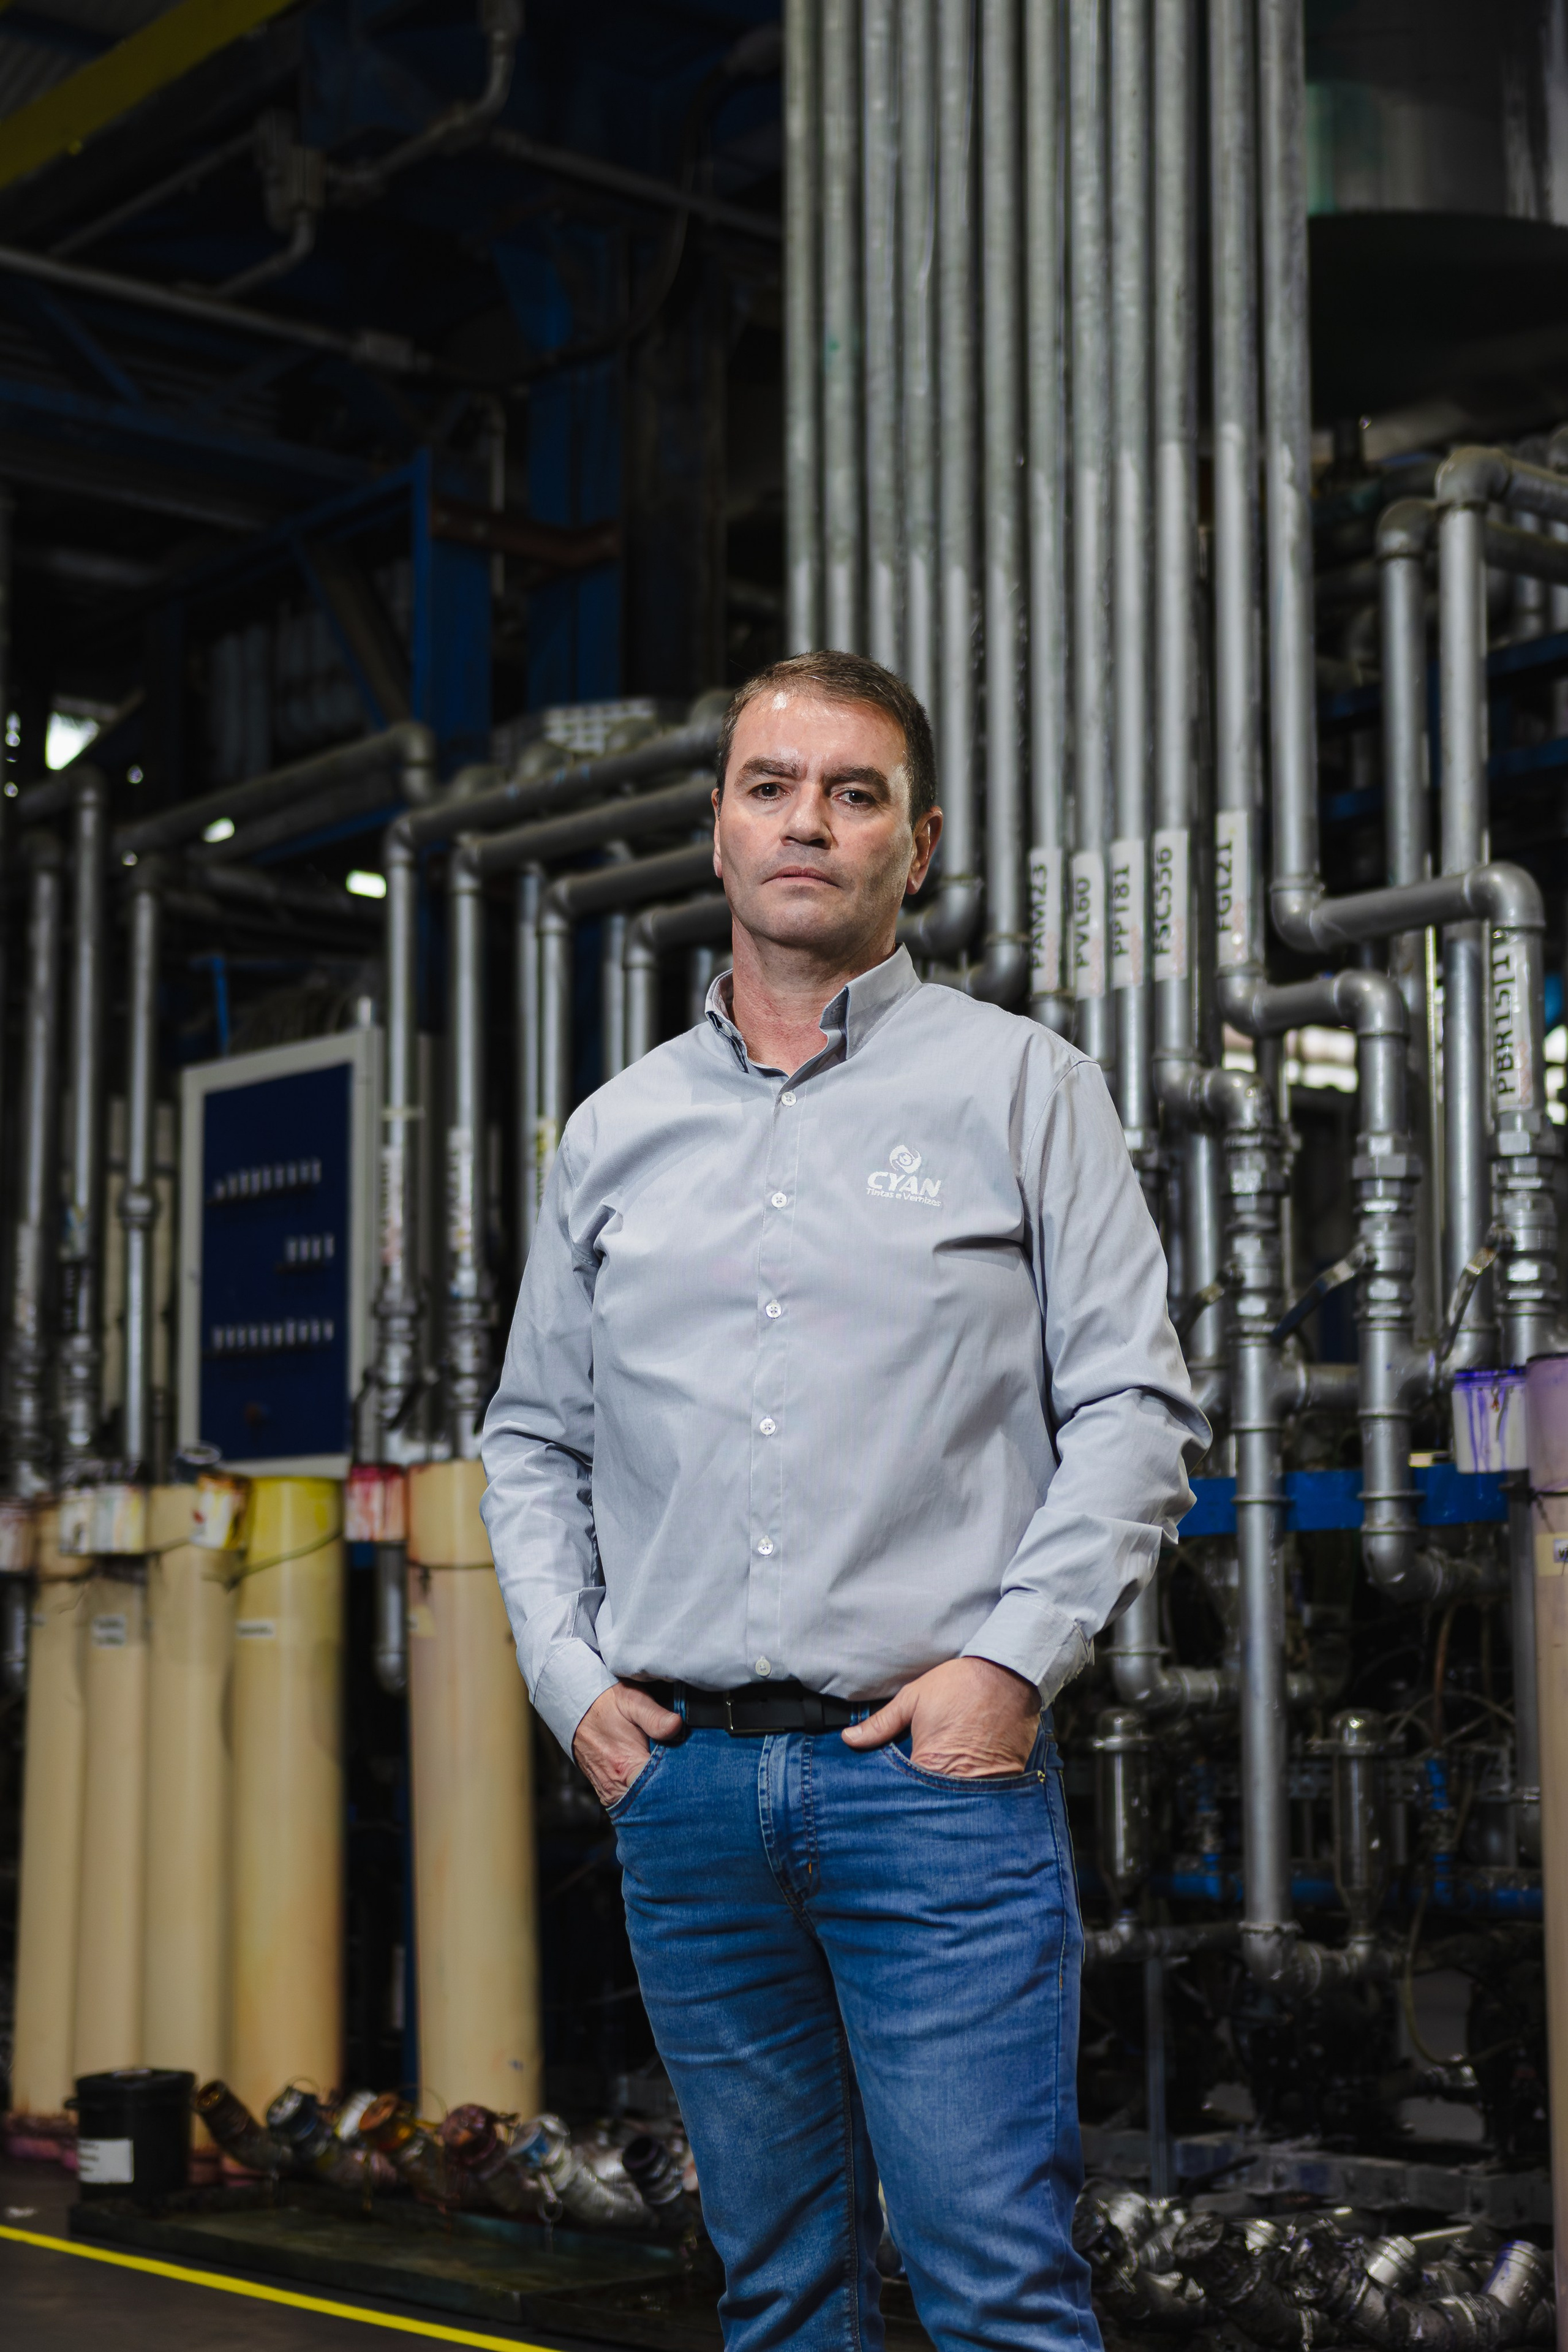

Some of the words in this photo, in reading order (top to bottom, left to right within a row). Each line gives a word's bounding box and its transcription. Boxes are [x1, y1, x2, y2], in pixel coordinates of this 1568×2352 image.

[867, 1171, 941, 1197] CYAN
[866, 1188, 894, 1199] Tintas
[903, 1193, 941, 1207] Vernizes
